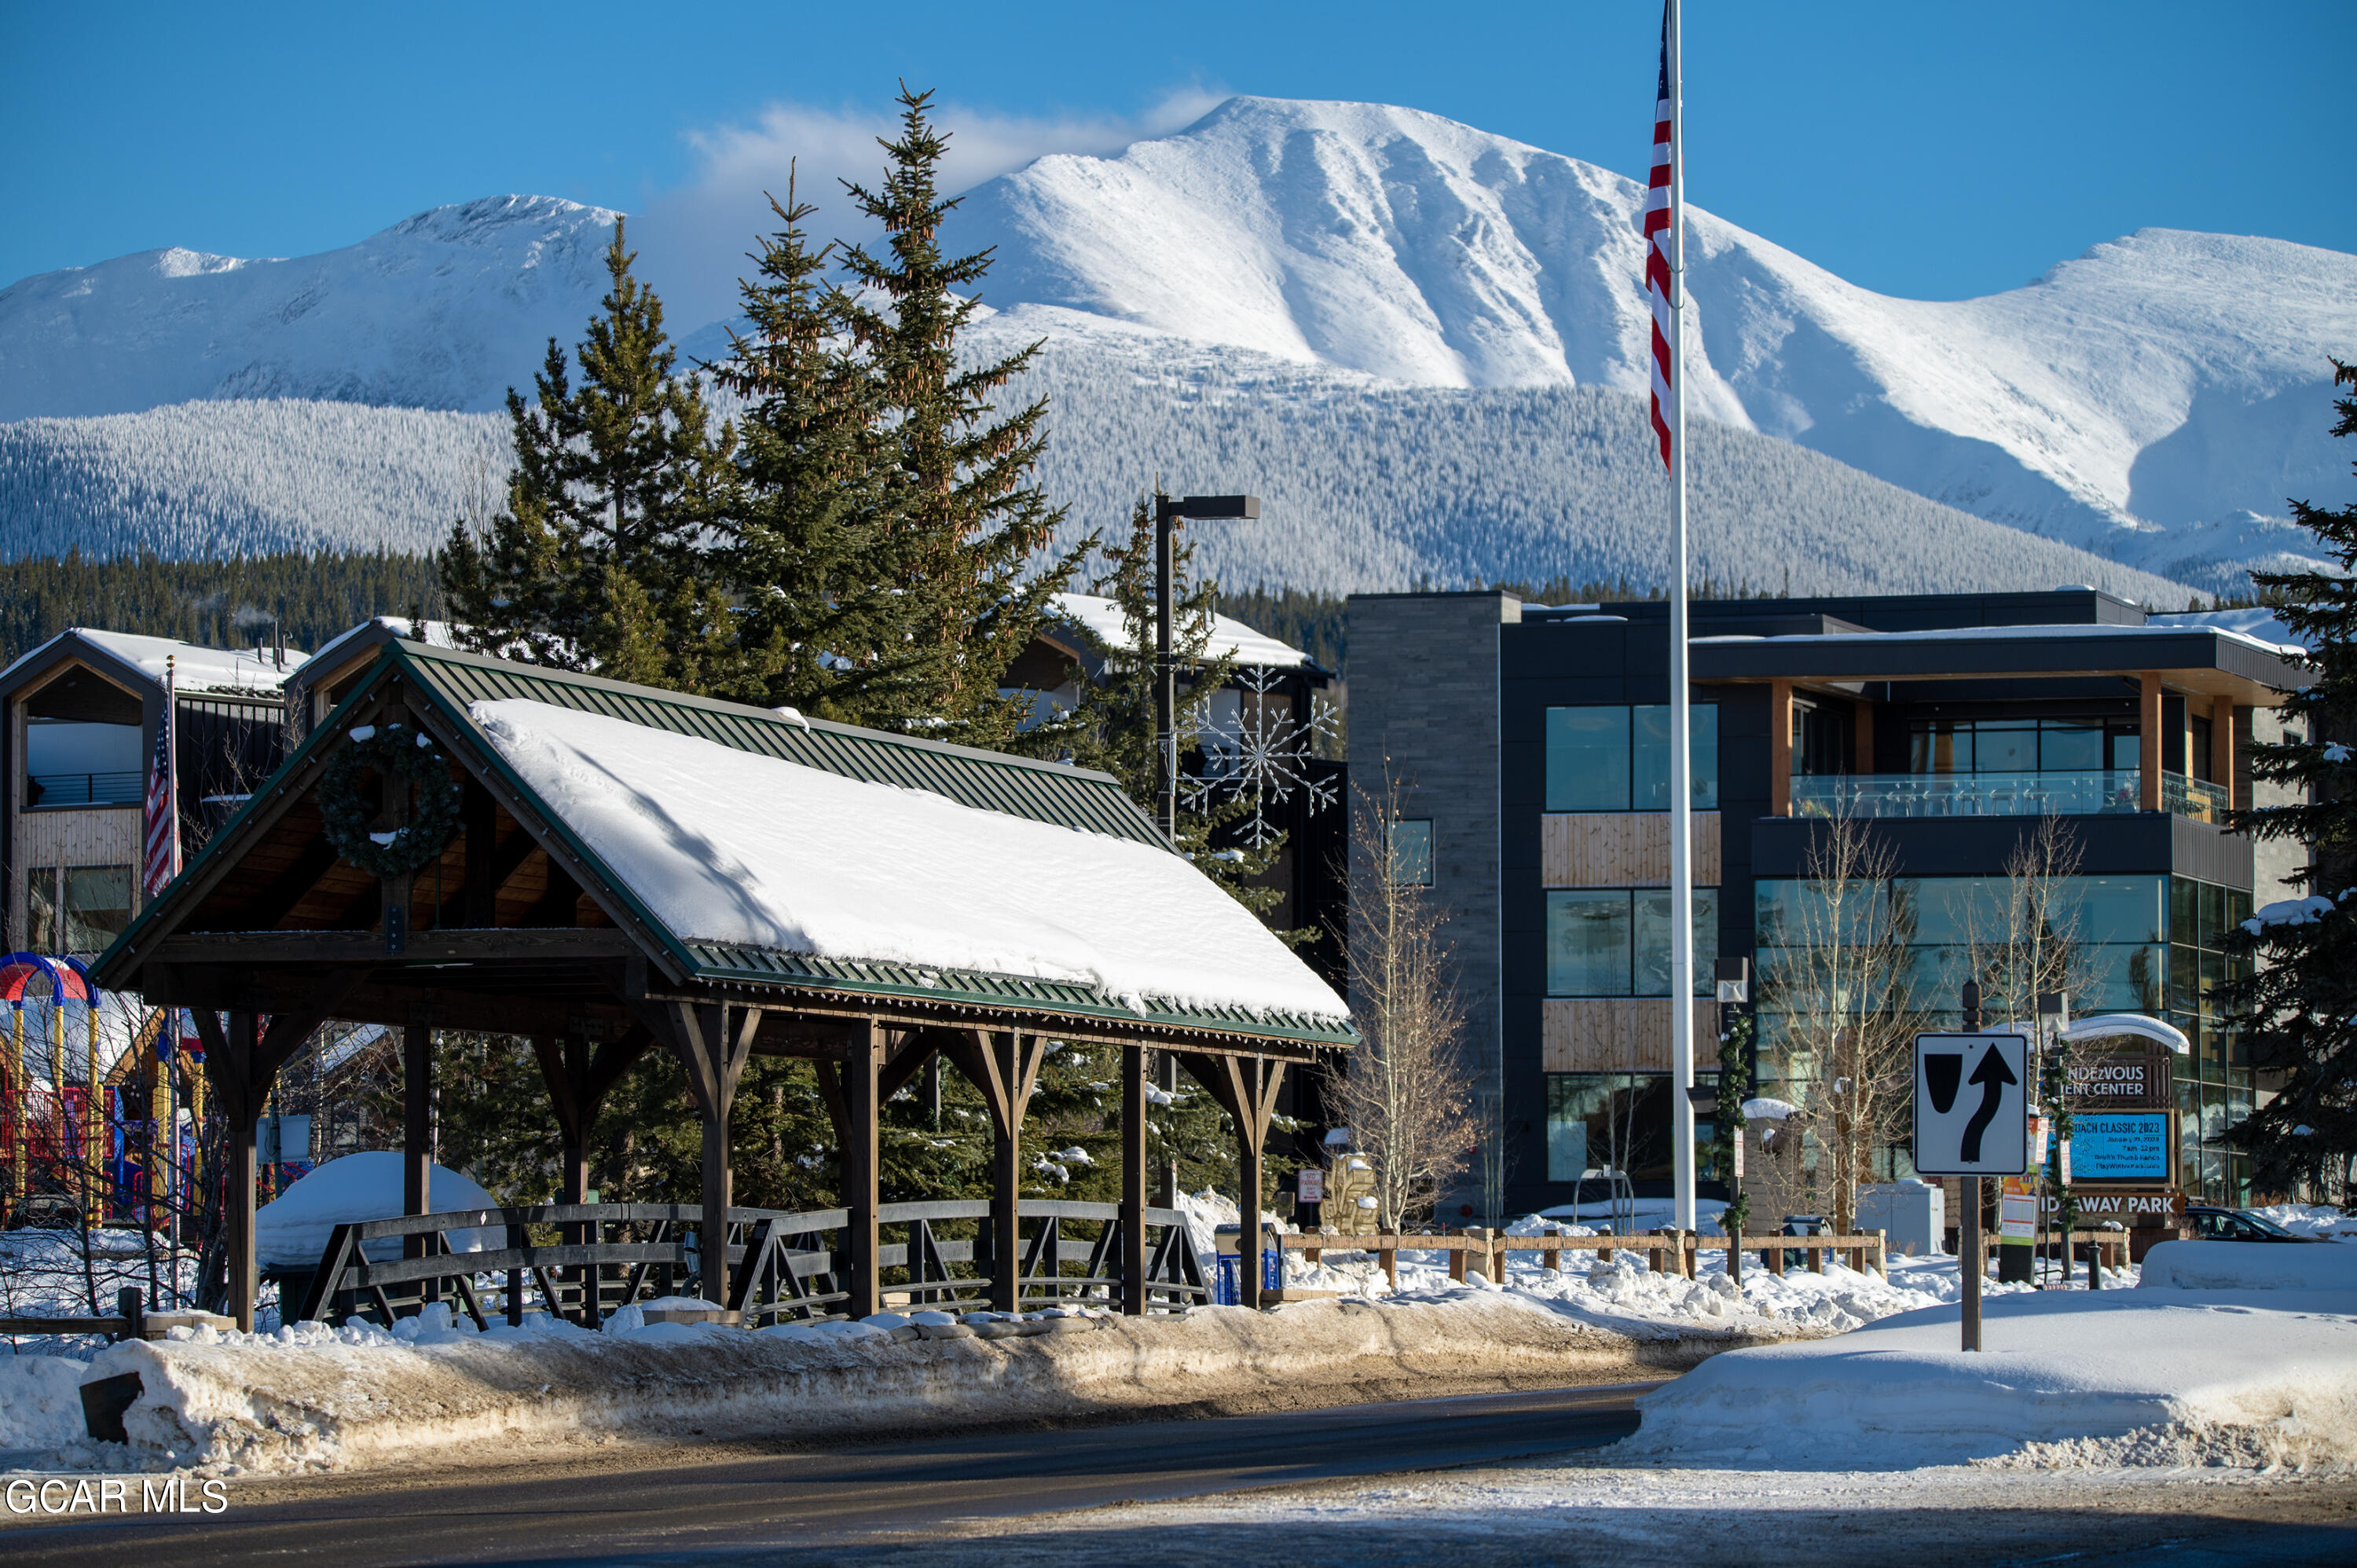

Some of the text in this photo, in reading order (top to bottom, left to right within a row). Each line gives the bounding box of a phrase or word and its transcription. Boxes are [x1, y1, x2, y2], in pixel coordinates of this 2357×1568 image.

[2068, 1066, 2144, 1080] NDEzVOUS
[2062, 1083, 2144, 1095] ENT CENTER
[2100, 1122, 2136, 1134] CLASSIC
[2138, 1122, 2160, 1134] 2023
[2128, 1196, 2175, 1212] PARK
